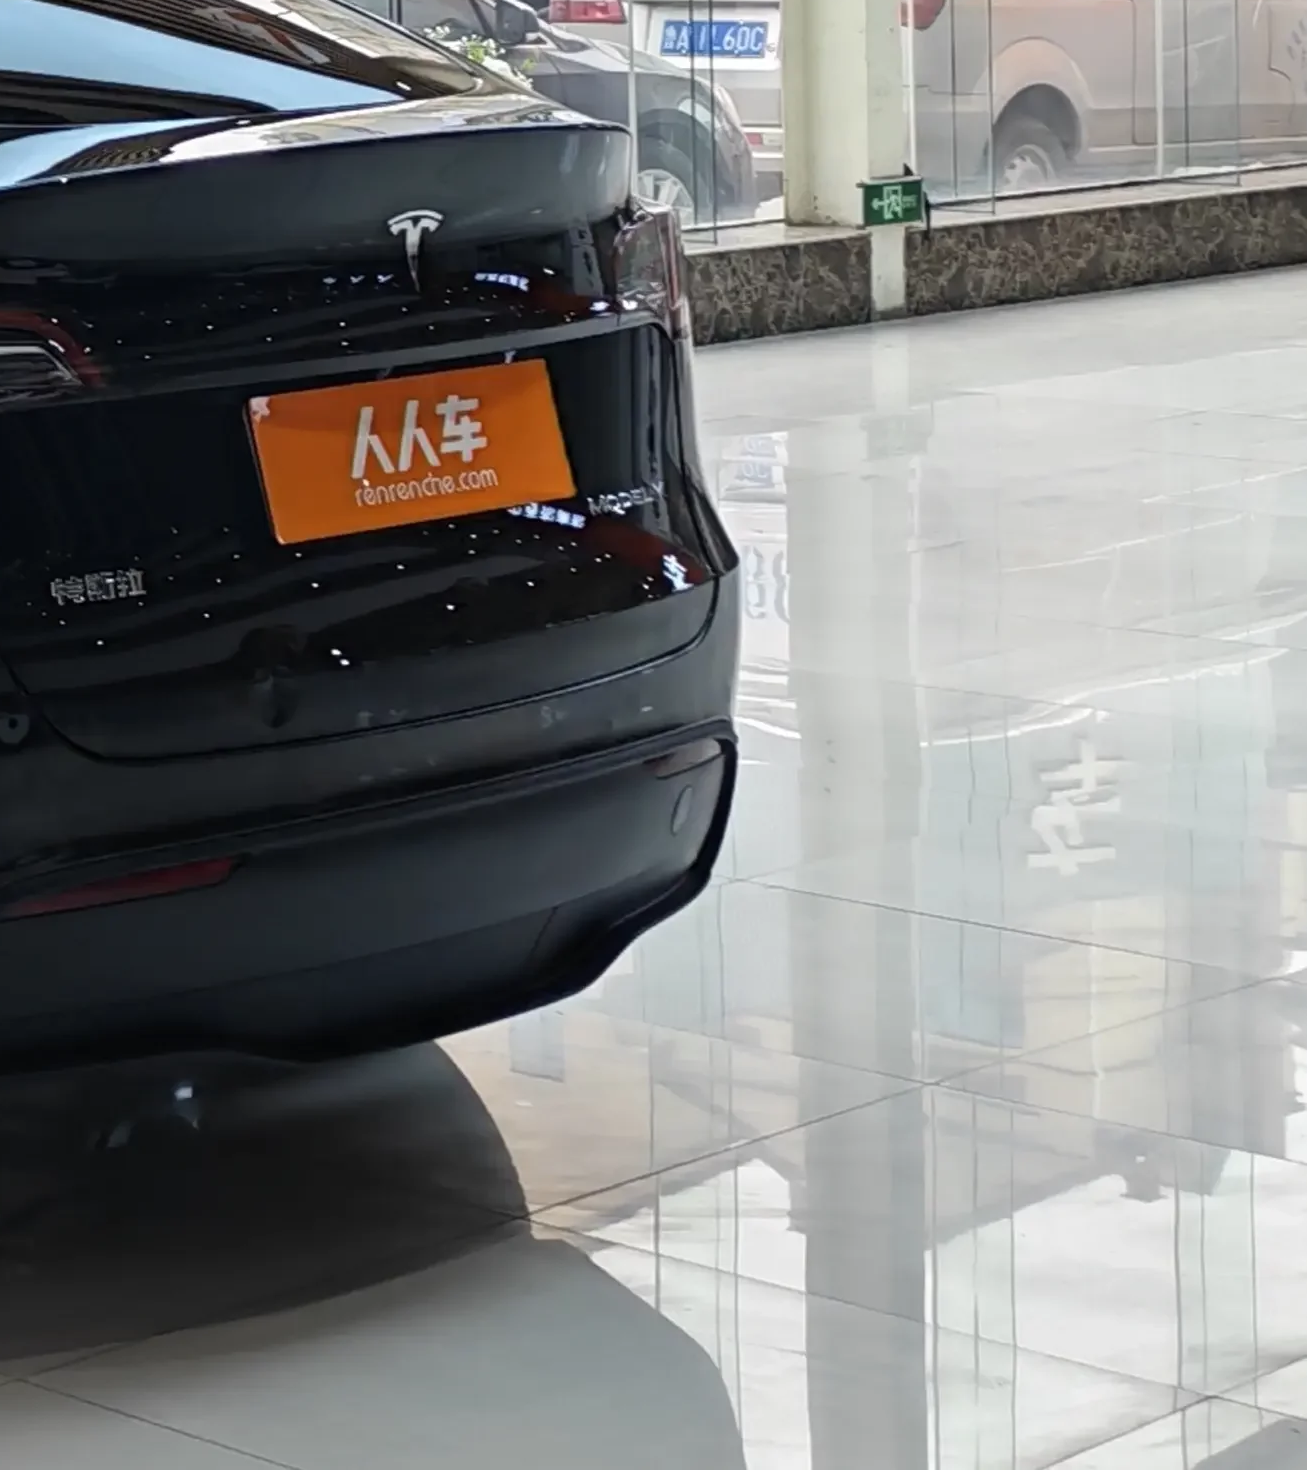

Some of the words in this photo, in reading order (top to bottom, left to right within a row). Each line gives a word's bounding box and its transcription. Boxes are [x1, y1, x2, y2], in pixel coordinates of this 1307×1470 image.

[351, 394, 488, 479] 人人车
[355, 468, 499, 507] renrenche.com
[50, 567, 148, 607] 特斯拉
